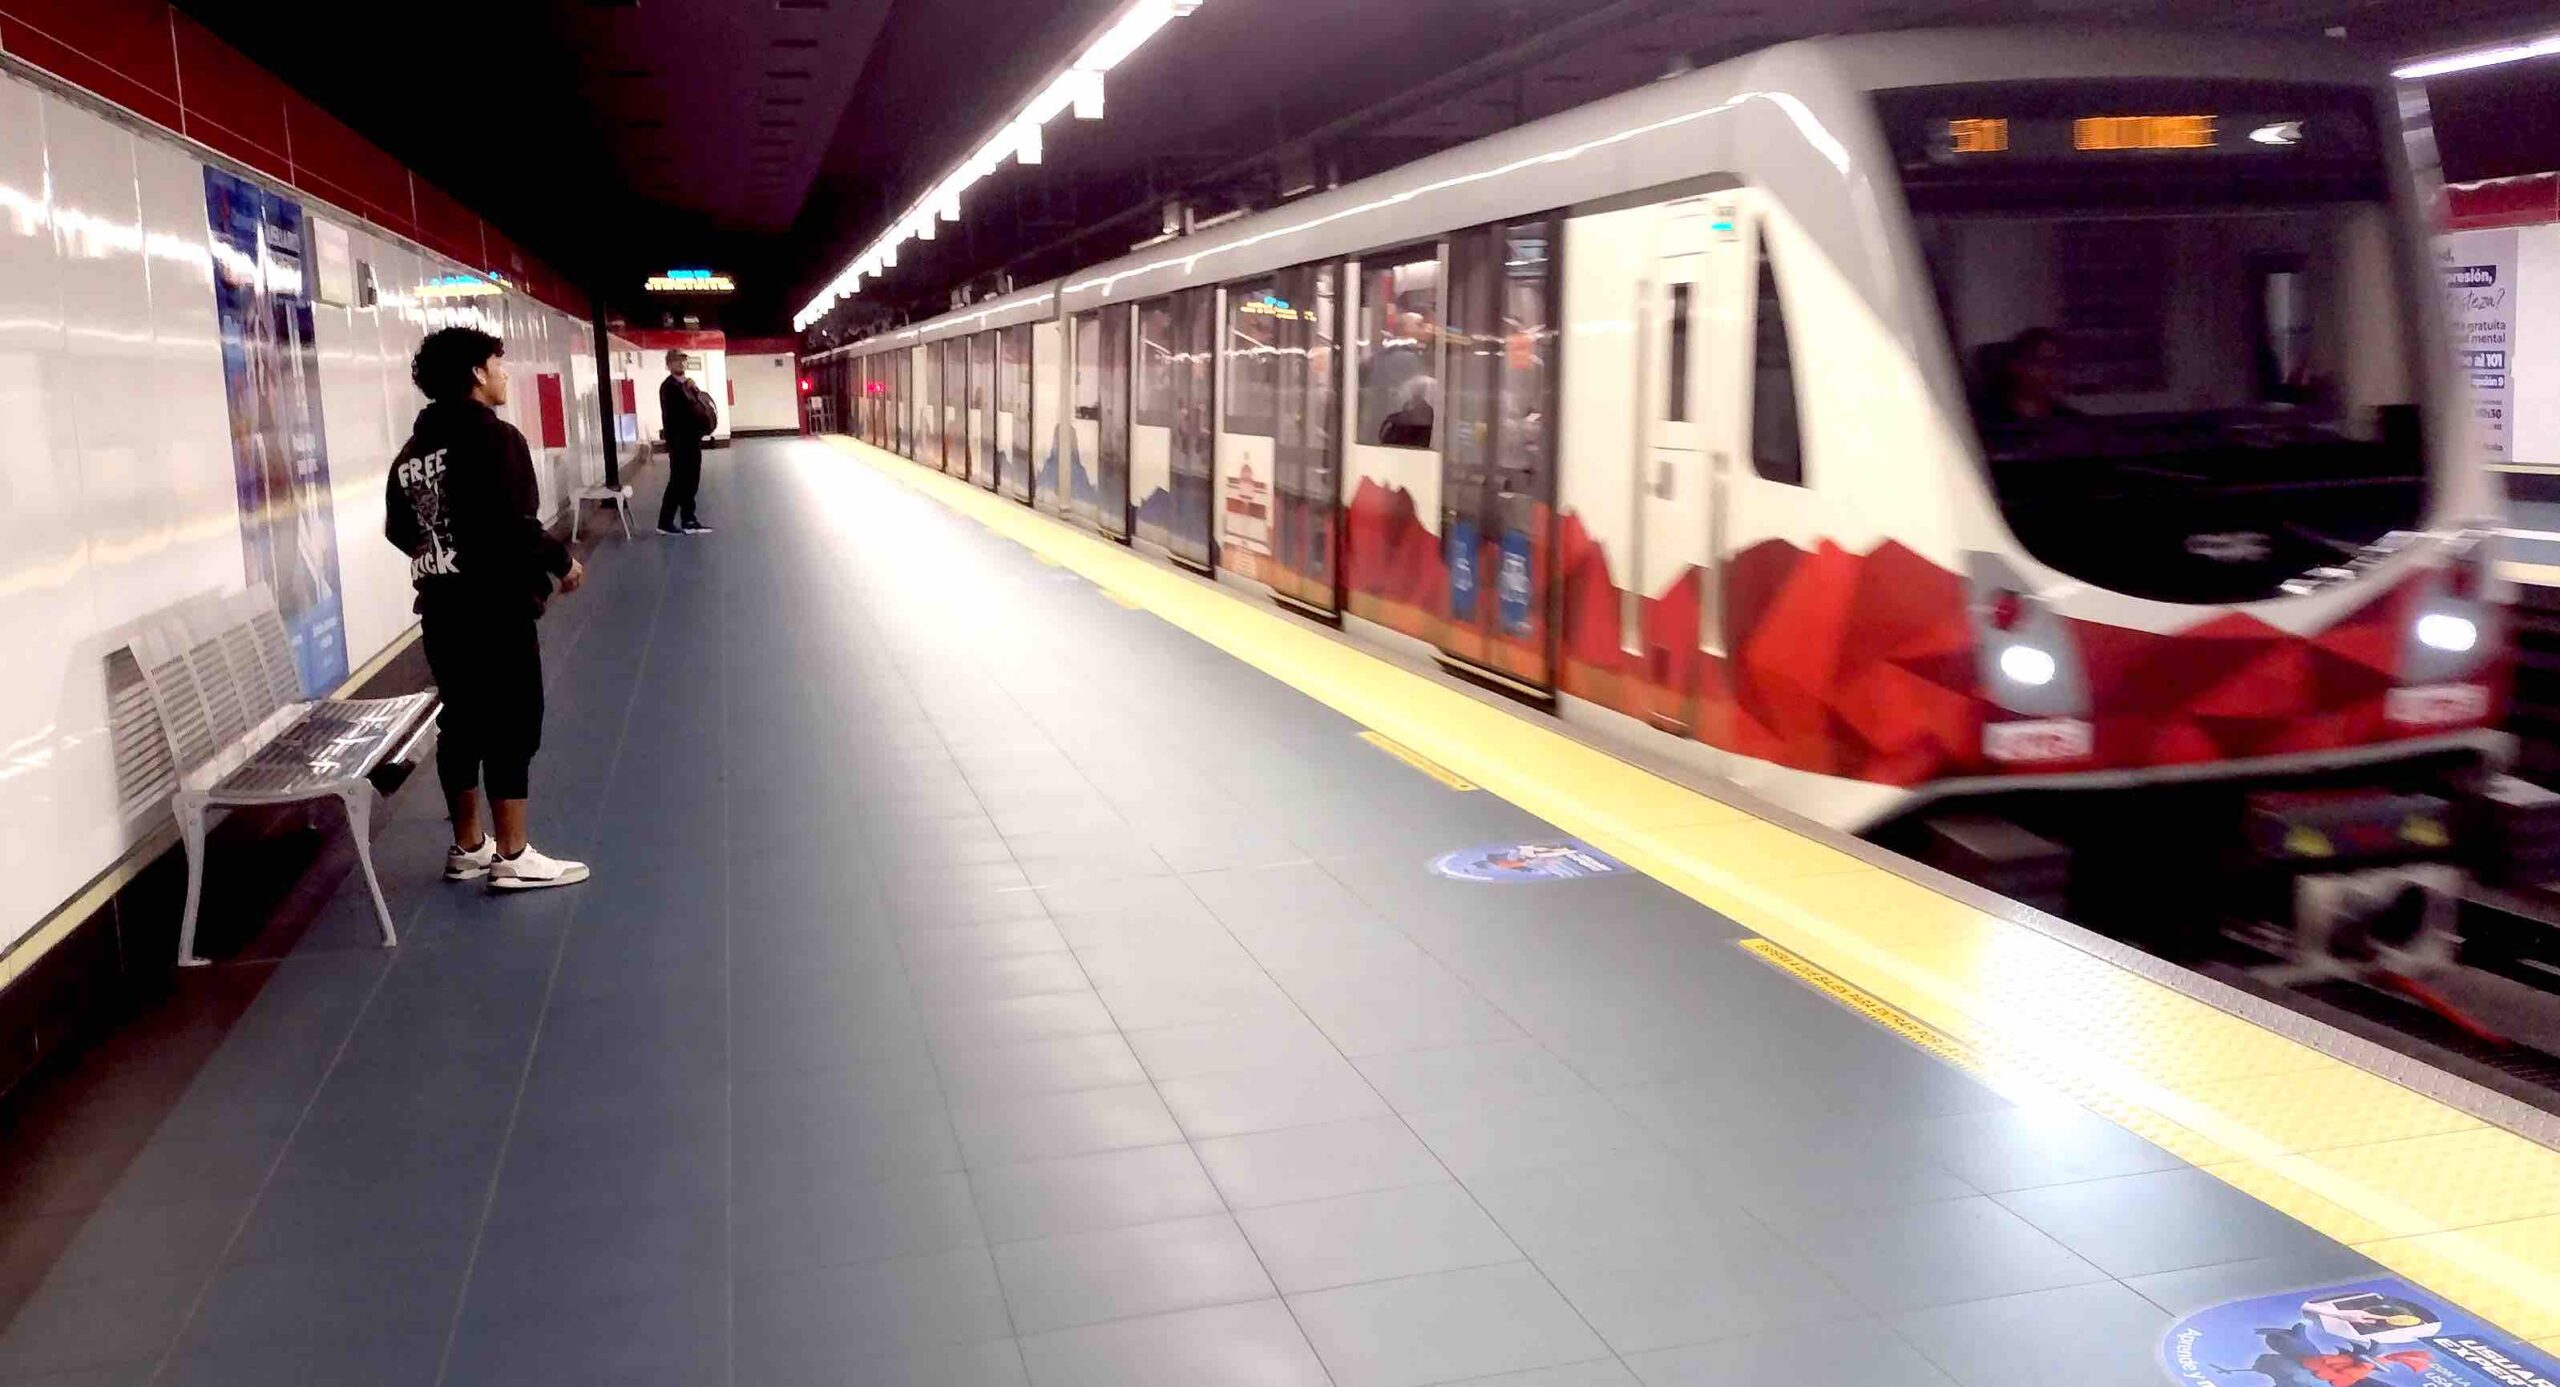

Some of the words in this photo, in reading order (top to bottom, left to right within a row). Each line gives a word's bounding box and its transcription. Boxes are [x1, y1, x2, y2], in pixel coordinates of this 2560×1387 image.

[2471, 332, 2506, 344] mental
[2486, 353, 2503, 368] 101
[398, 448, 448, 489] FREE
[2176, 1328, 2203, 1371] Aprende
[2433, 1338, 2534, 1387] EXPER
